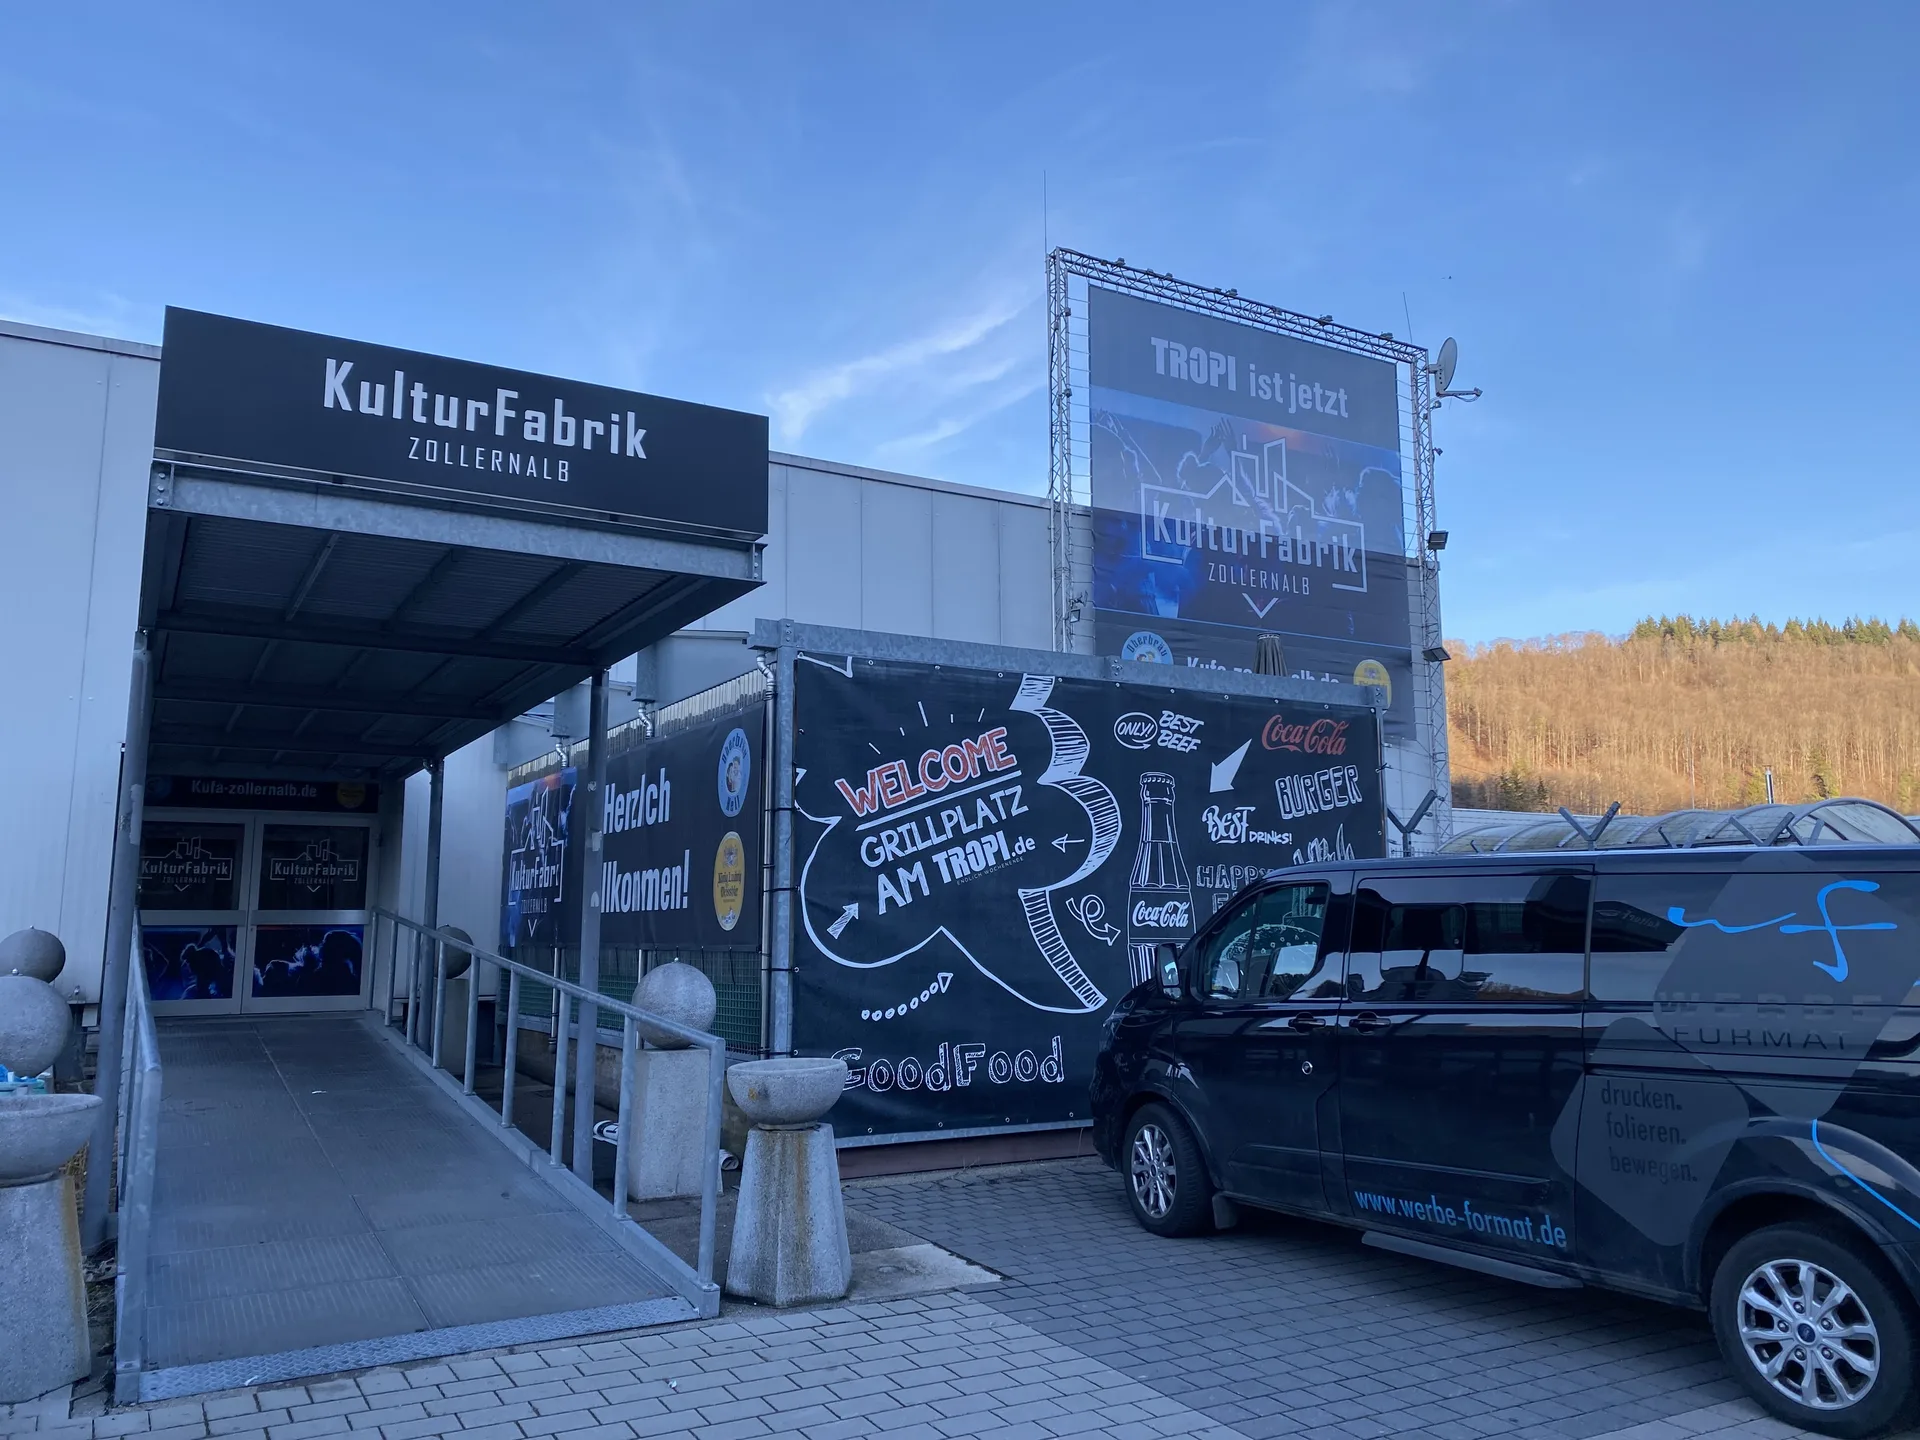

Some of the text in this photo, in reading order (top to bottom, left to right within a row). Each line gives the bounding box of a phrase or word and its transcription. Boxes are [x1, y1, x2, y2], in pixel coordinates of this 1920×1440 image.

[1150, 336, 1349, 419] TROPI ist jetzt
[323, 357, 648, 460] KulturFabrik
[407, 436, 570, 482] ZOLLERNALB
[1152, 499, 1358, 574] KulturFabrik
[1207, 562, 1310, 595] ZOLLERNALB
[1126, 634, 1168, 657] Oberbräu
[1117, 721, 1155, 738] ONLY!
[1159, 710, 1205, 734] BEST
[1261, 714, 1350, 756] Coca-Cola
[1157, 729, 1201, 753] BEEF
[191, 779, 317, 798] Kufa-zollernalb.de
[834, 726, 1018, 818] WELCOME
[1275, 765, 1363, 820] BURGER
[860, 785, 1030, 868] GRILLPLATZ
[1249, 829, 1292, 845] DRINKS!
[141, 860, 229, 875] KulturFabrik
[274, 862, 355, 877] KulturFabrik
[877, 830, 1036, 915] AM TROPI.de
[1132, 899, 1191, 928] Coca-Cola
[1658, 991, 1883, 1023] WERBE
[1600, 1079, 1683, 1111] drucken.
[1606, 1111, 1687, 1145] folieren.
[1608, 1146, 1698, 1185] bewegen.
[1354, 1190, 1568, 1249] www.werbe-format.de
